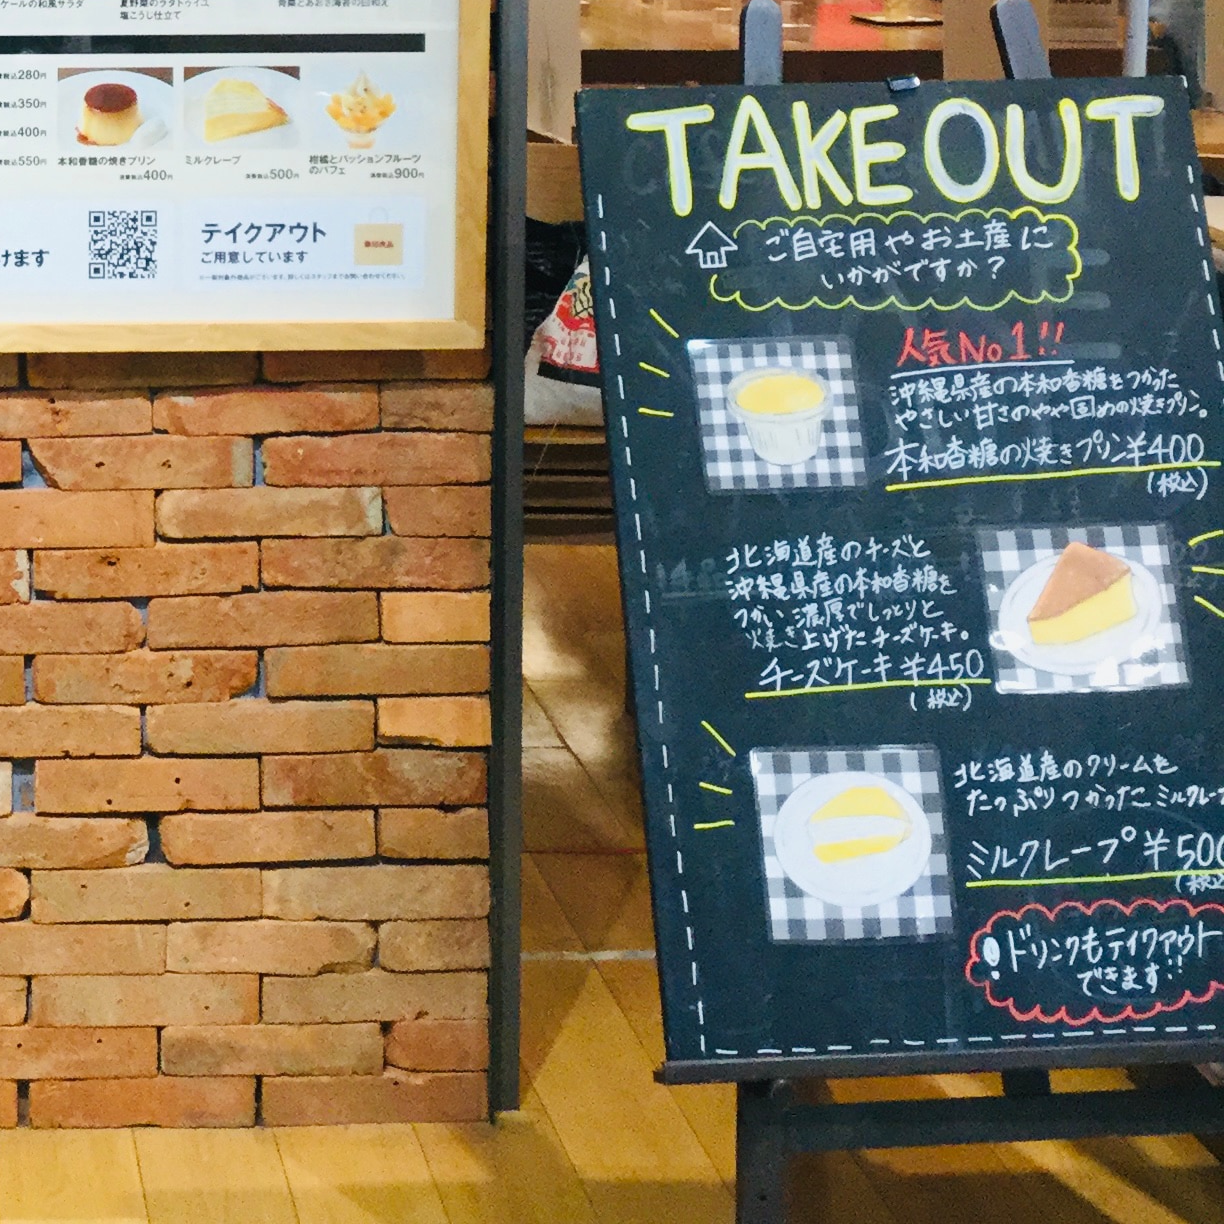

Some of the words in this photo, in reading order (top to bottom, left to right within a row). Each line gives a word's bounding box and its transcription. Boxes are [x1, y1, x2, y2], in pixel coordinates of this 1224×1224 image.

[626, 95, 914, 216] TAKE
[923, 94, 1165, 204] OUT
[201, 222, 327, 243] テイクアウト
[201, 251, 309, 264] ご用意しています
